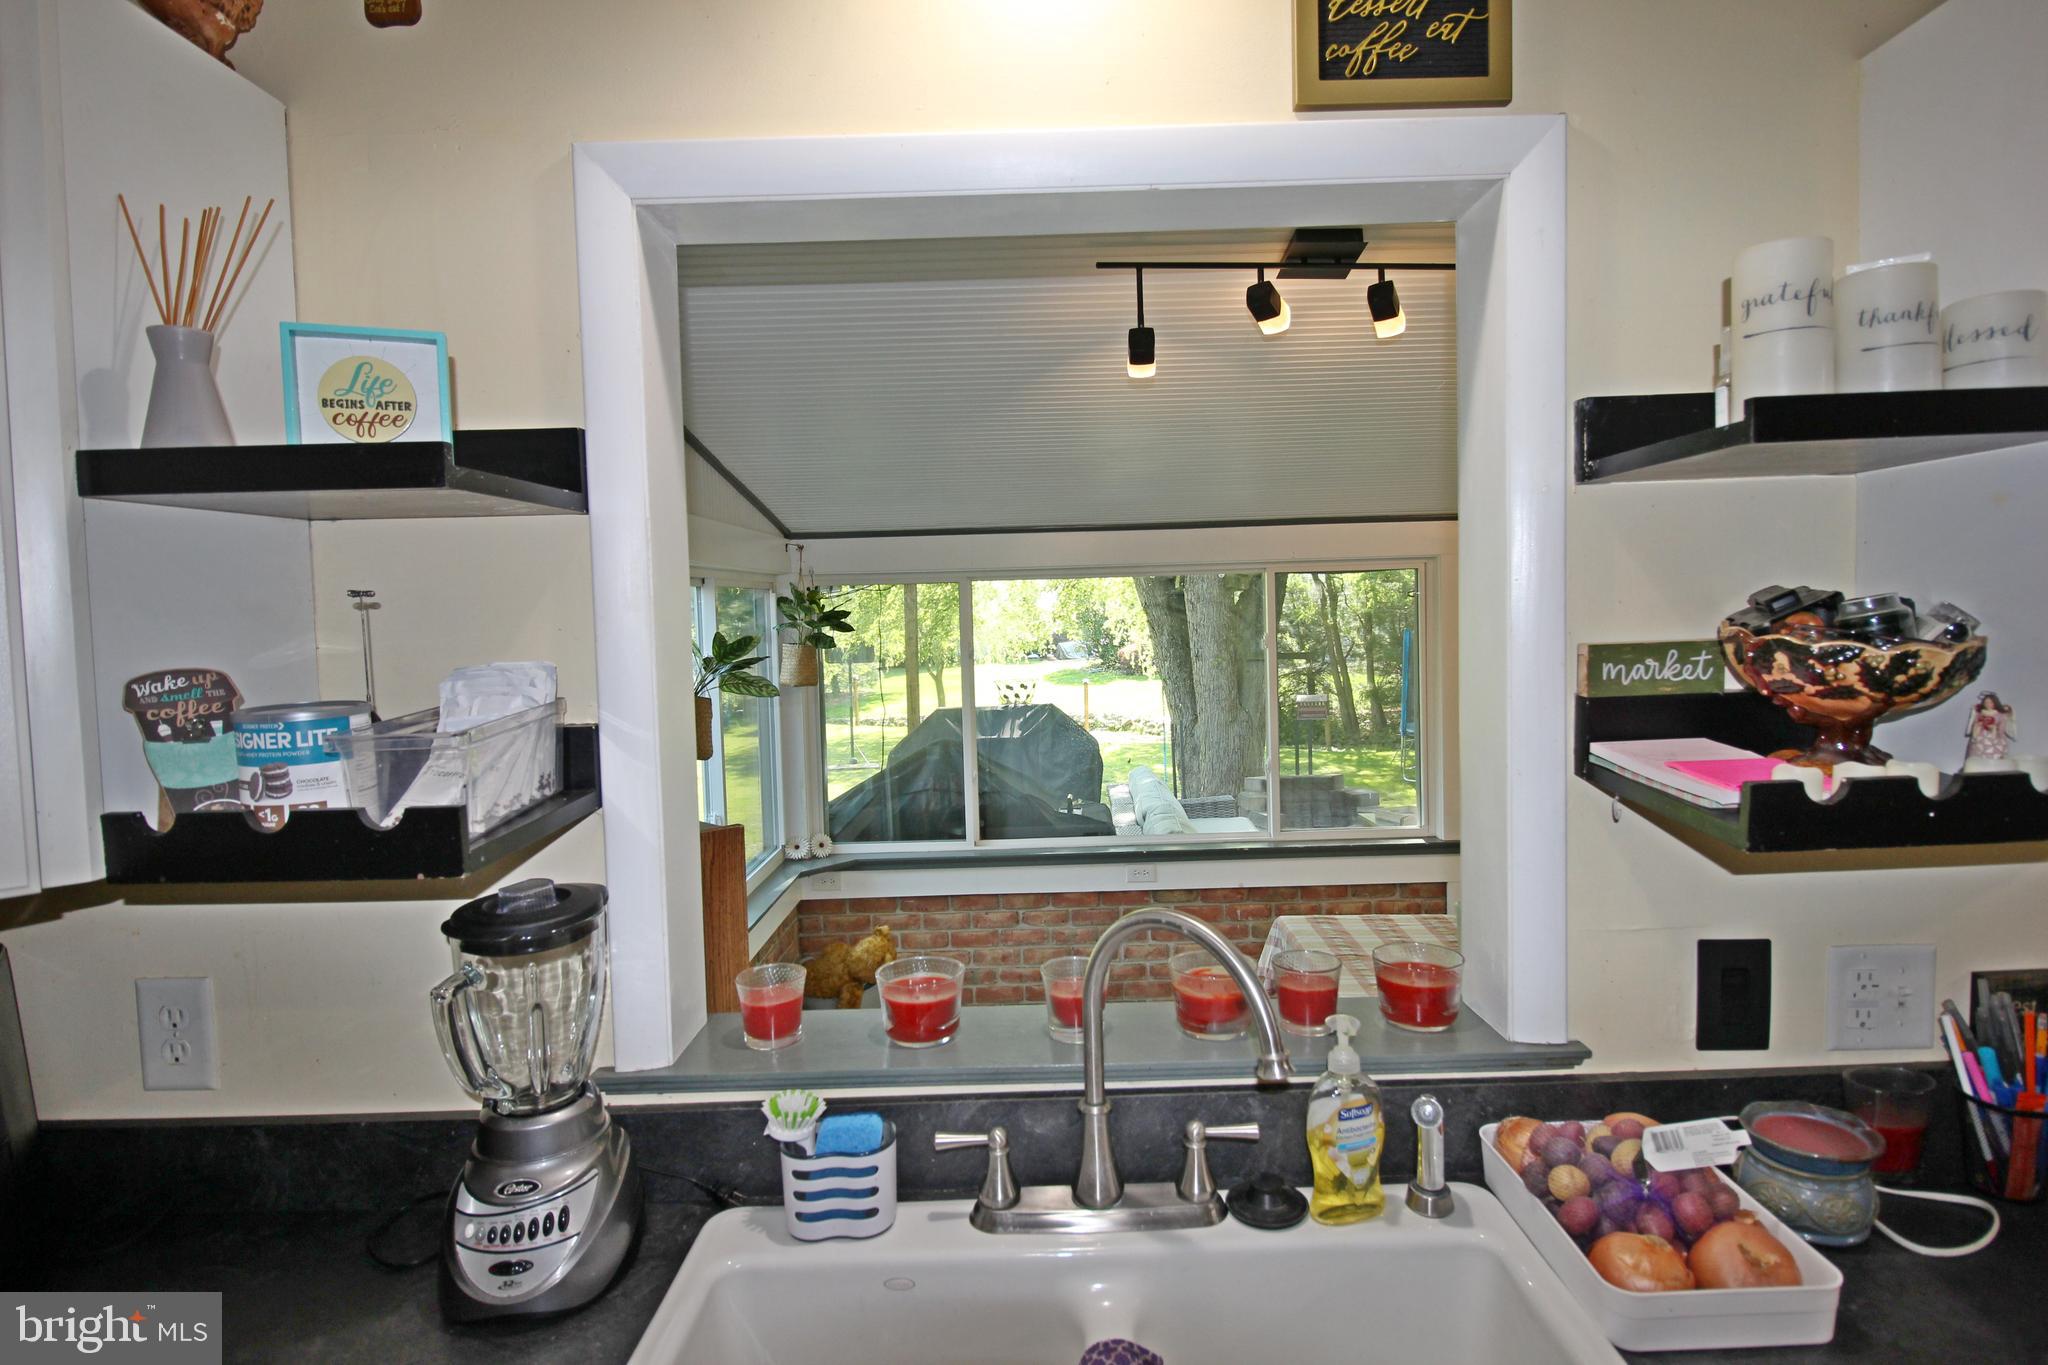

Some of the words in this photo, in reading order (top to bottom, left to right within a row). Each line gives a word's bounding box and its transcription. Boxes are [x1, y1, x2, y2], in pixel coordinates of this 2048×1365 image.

[1426, 8, 1489, 44] eat
[1325, 20, 1418, 77] coffee
[1858, 301, 1938, 335] thankf
[334, 362, 397, 408] Life
[321, 398, 365, 410] BEGINS
[375, 400, 412, 412] AFTER
[332, 411, 408, 438] coffee
[1602, 649, 1714, 686] market
[131, 675, 190, 698] Wake
[192, 672, 218, 689] up
[138, 695, 159, 705] AND
[160, 687, 204, 703] smell
[205, 689, 226, 698] THE
[146, 700, 225, 728] coffee
[236, 731, 292, 749] SIGNER
